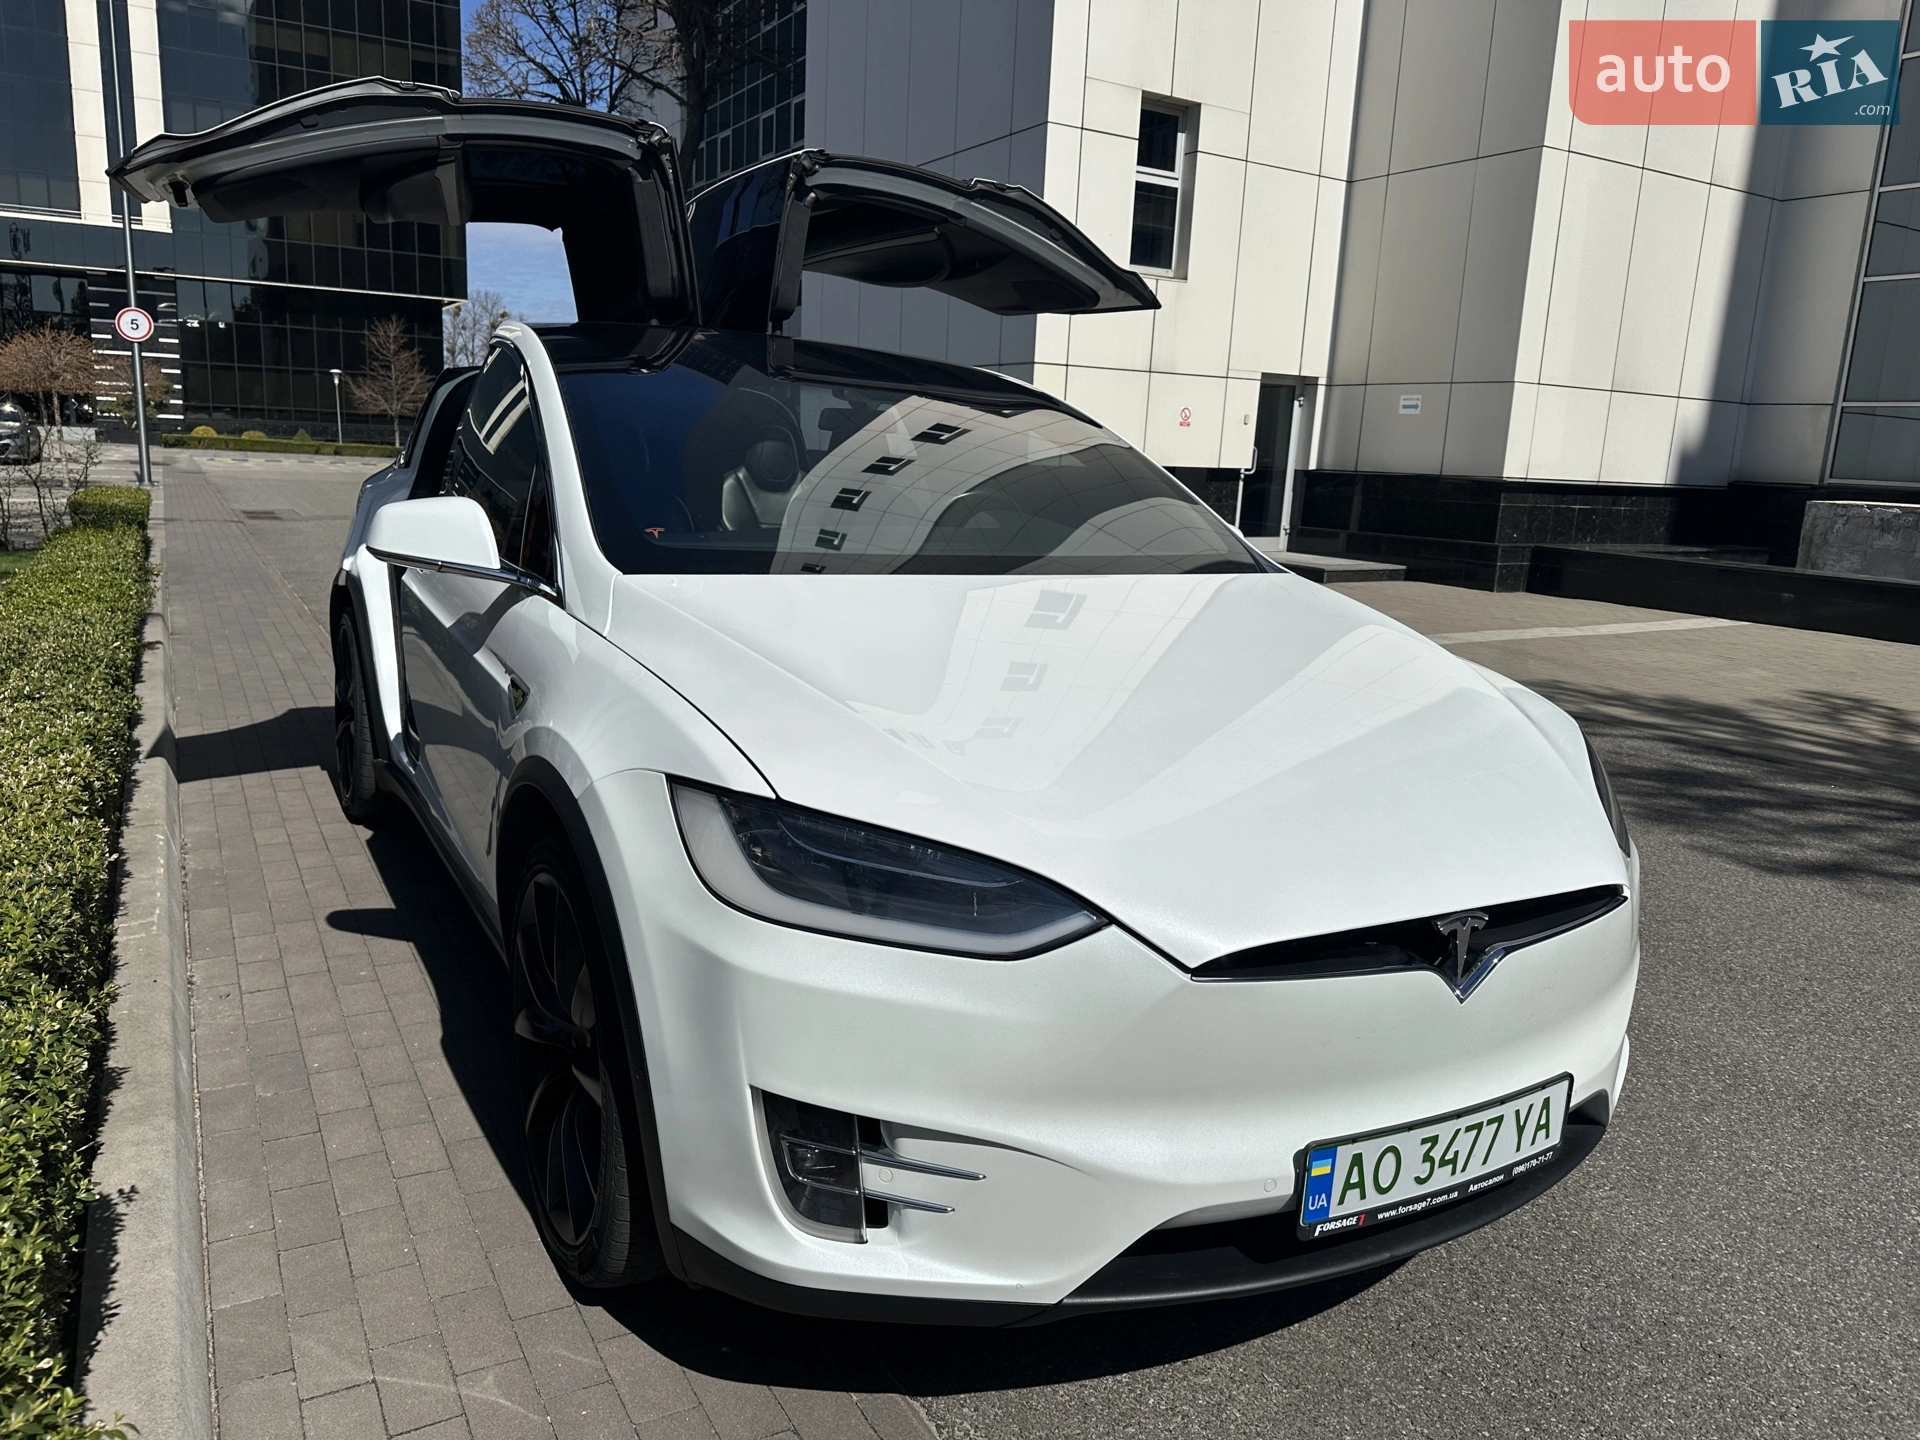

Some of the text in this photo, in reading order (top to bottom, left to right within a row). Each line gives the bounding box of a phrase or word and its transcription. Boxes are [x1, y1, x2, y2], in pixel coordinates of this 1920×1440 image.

[130, 318, 139, 331] 5
[1337, 1095, 1551, 1206] AO 3477 YA
[1308, 1193, 1328, 1210] UA
[1377, 1191, 1459, 1220] www.forsage7.com.ua
